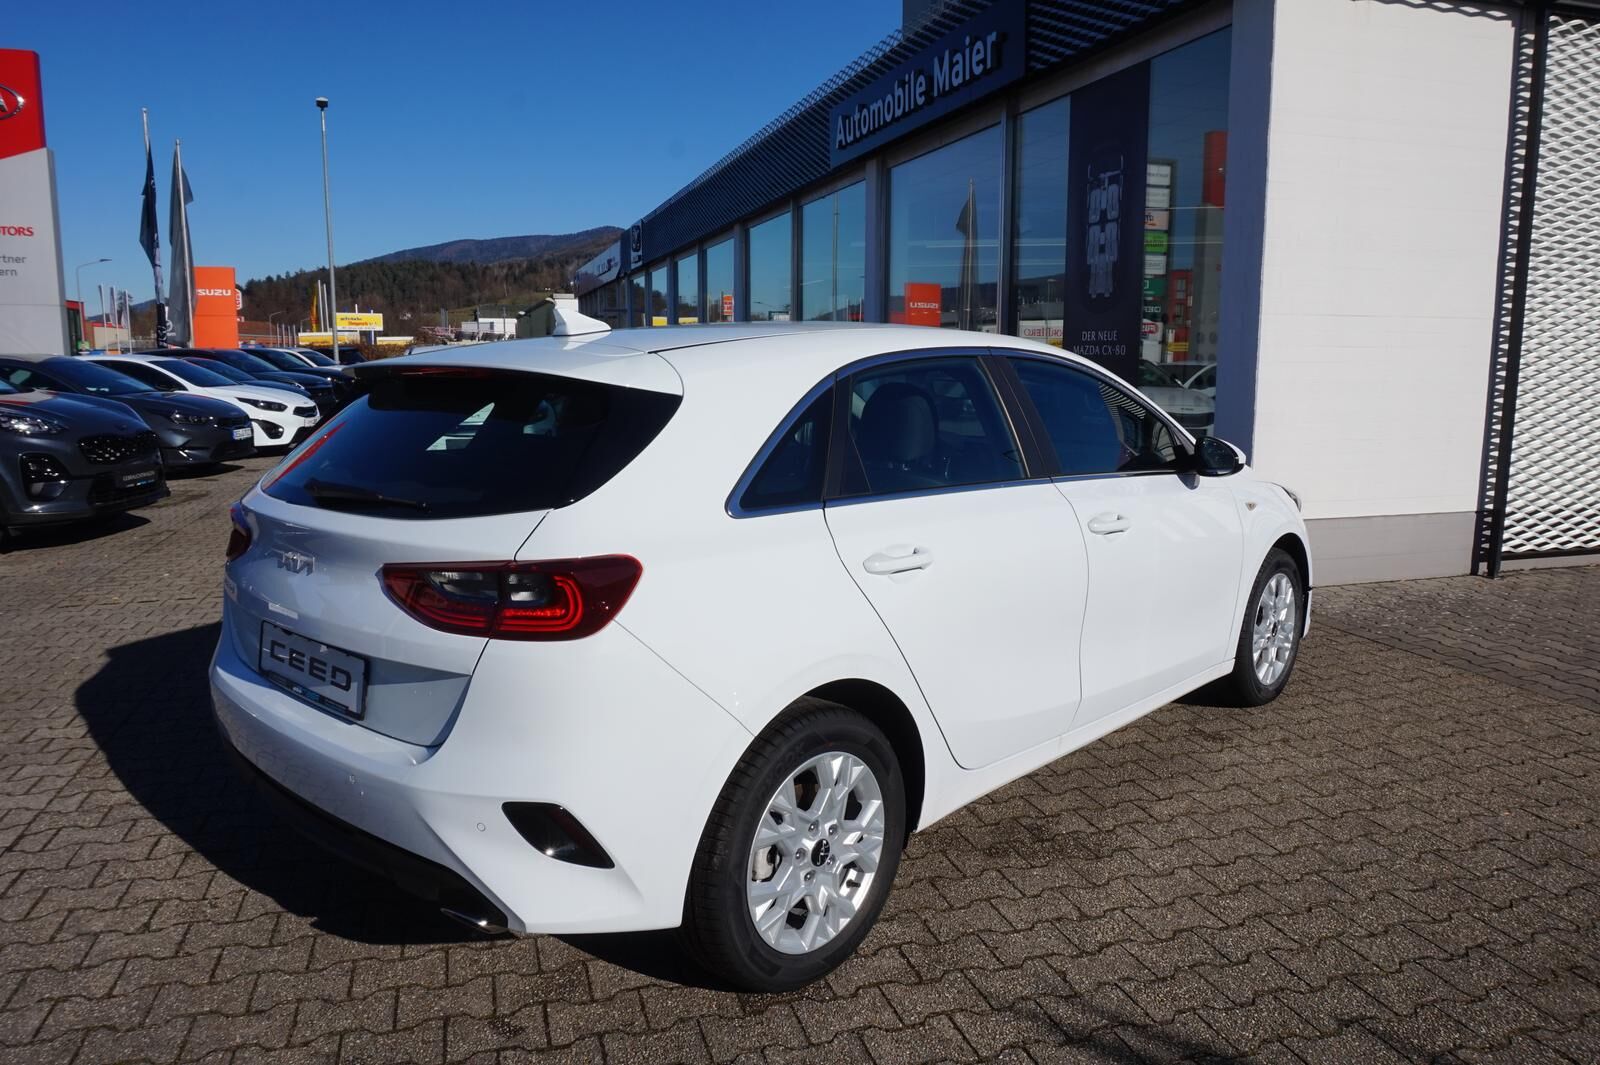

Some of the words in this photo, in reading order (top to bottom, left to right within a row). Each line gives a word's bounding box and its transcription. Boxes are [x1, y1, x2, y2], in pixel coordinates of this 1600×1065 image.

[835, 69, 926, 149] Automobile
[932, 31, 997, 97] Maier
[0, 226, 34, 237] TORS
[0, 254, 27, 264] tner
[195, 288, 232, 296] SUZU
[1081, 331, 1096, 341] DER
[1098, 330, 1118, 341] NEUE
[1073, 344, 1100, 355] MAZDA
[1102, 344, 1126, 356] CX-80
[270, 639, 352, 692] CEED
